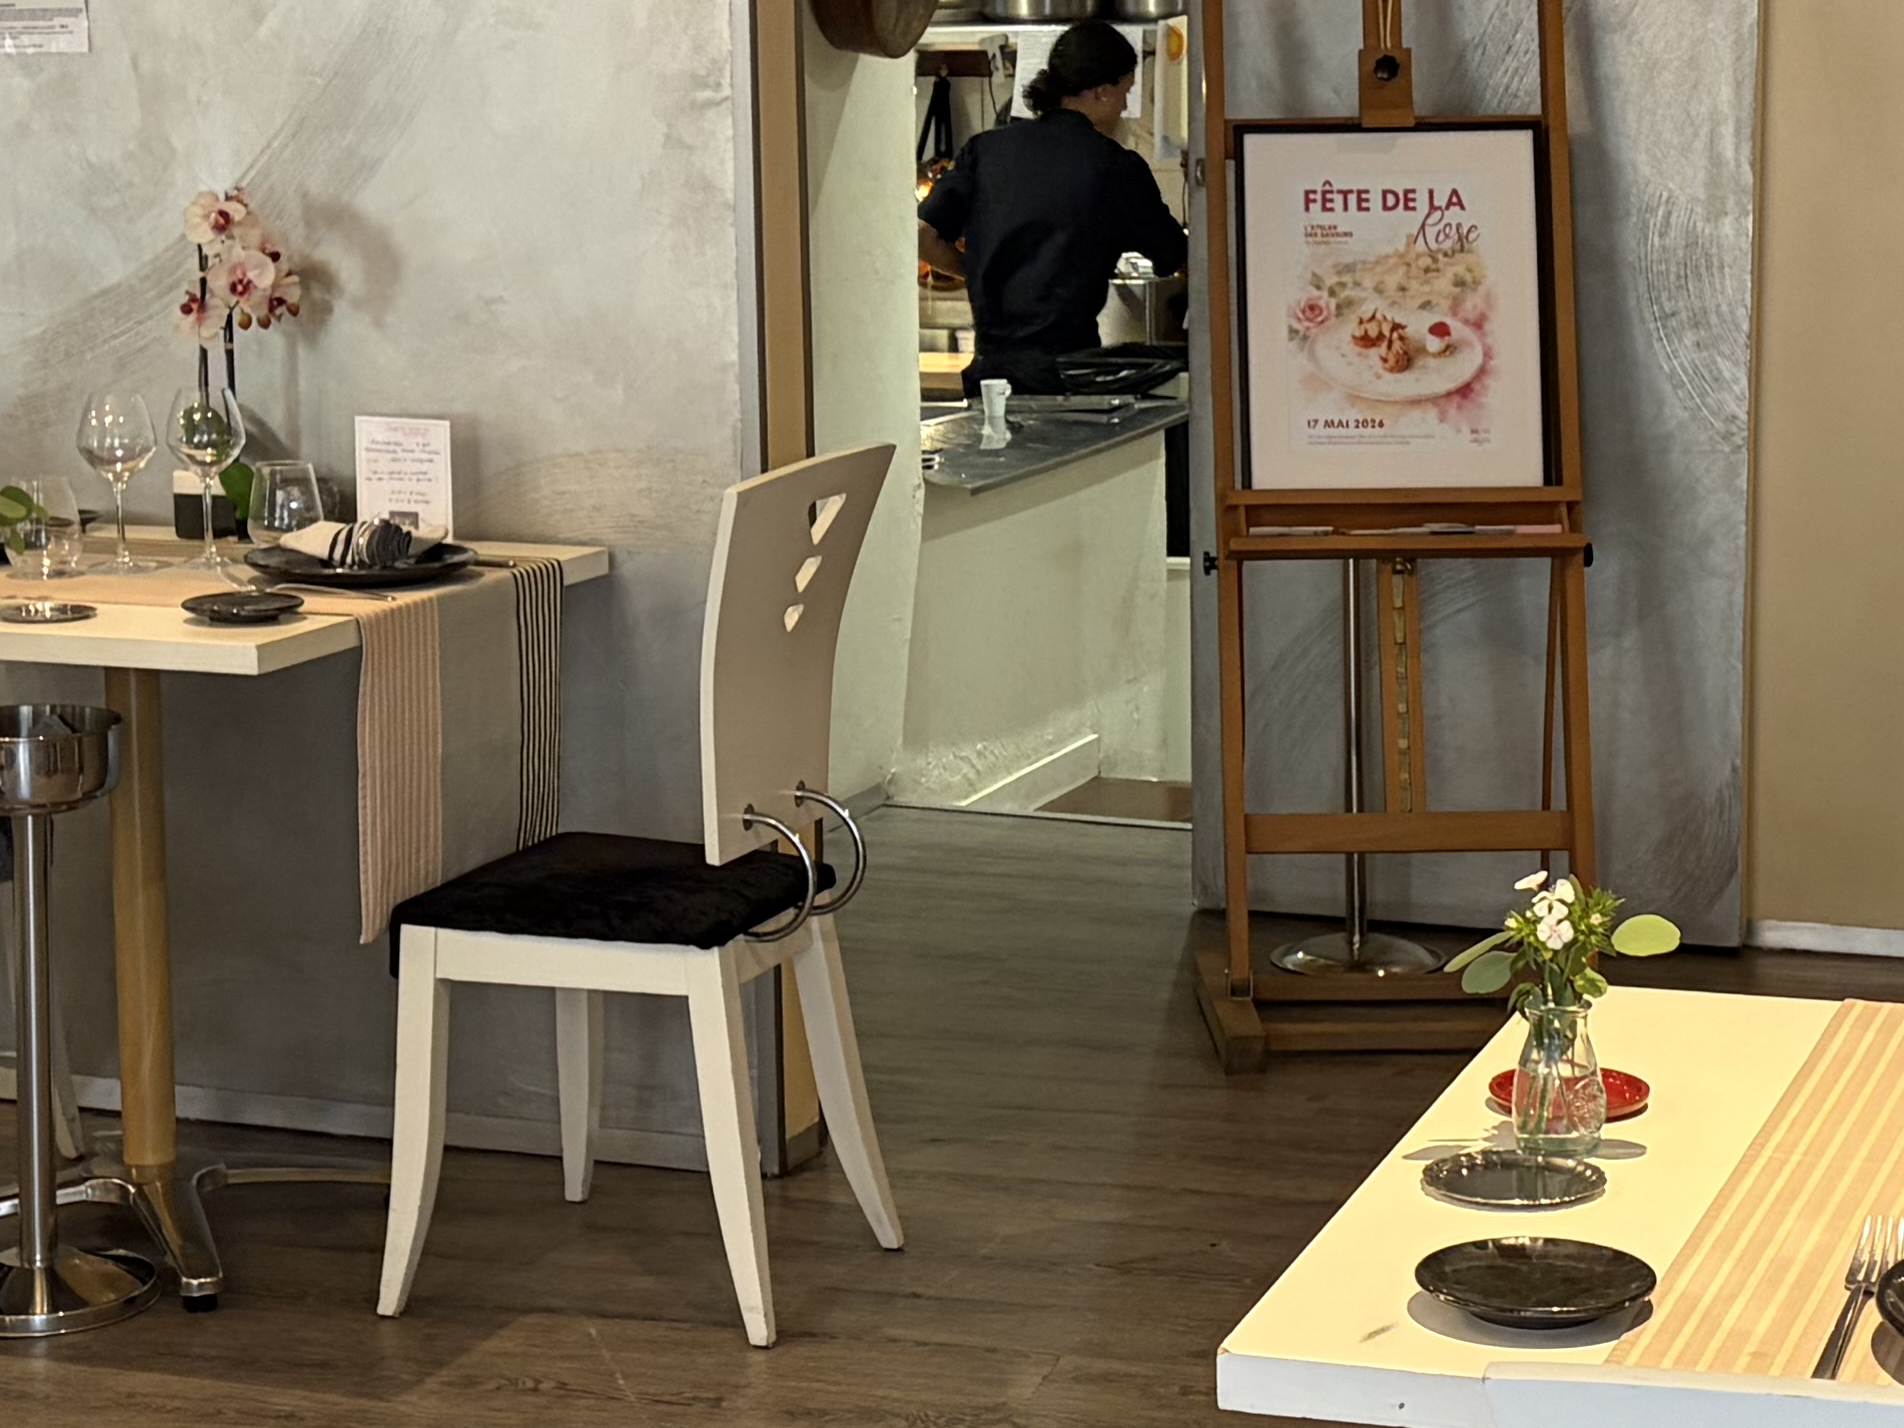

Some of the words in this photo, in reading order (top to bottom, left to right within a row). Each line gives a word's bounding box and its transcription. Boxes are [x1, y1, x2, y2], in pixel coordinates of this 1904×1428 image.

[1303, 179, 1371, 213] FÊTE
[1381, 188, 1418, 212] DE
[1428, 187, 1467, 212] LA
[1413, 206, 1481, 254] Rose
[1307, 419, 1319, 429] 17
[1323, 419, 1350, 429] MAI
[1354, 418, 1385, 429] 2026
